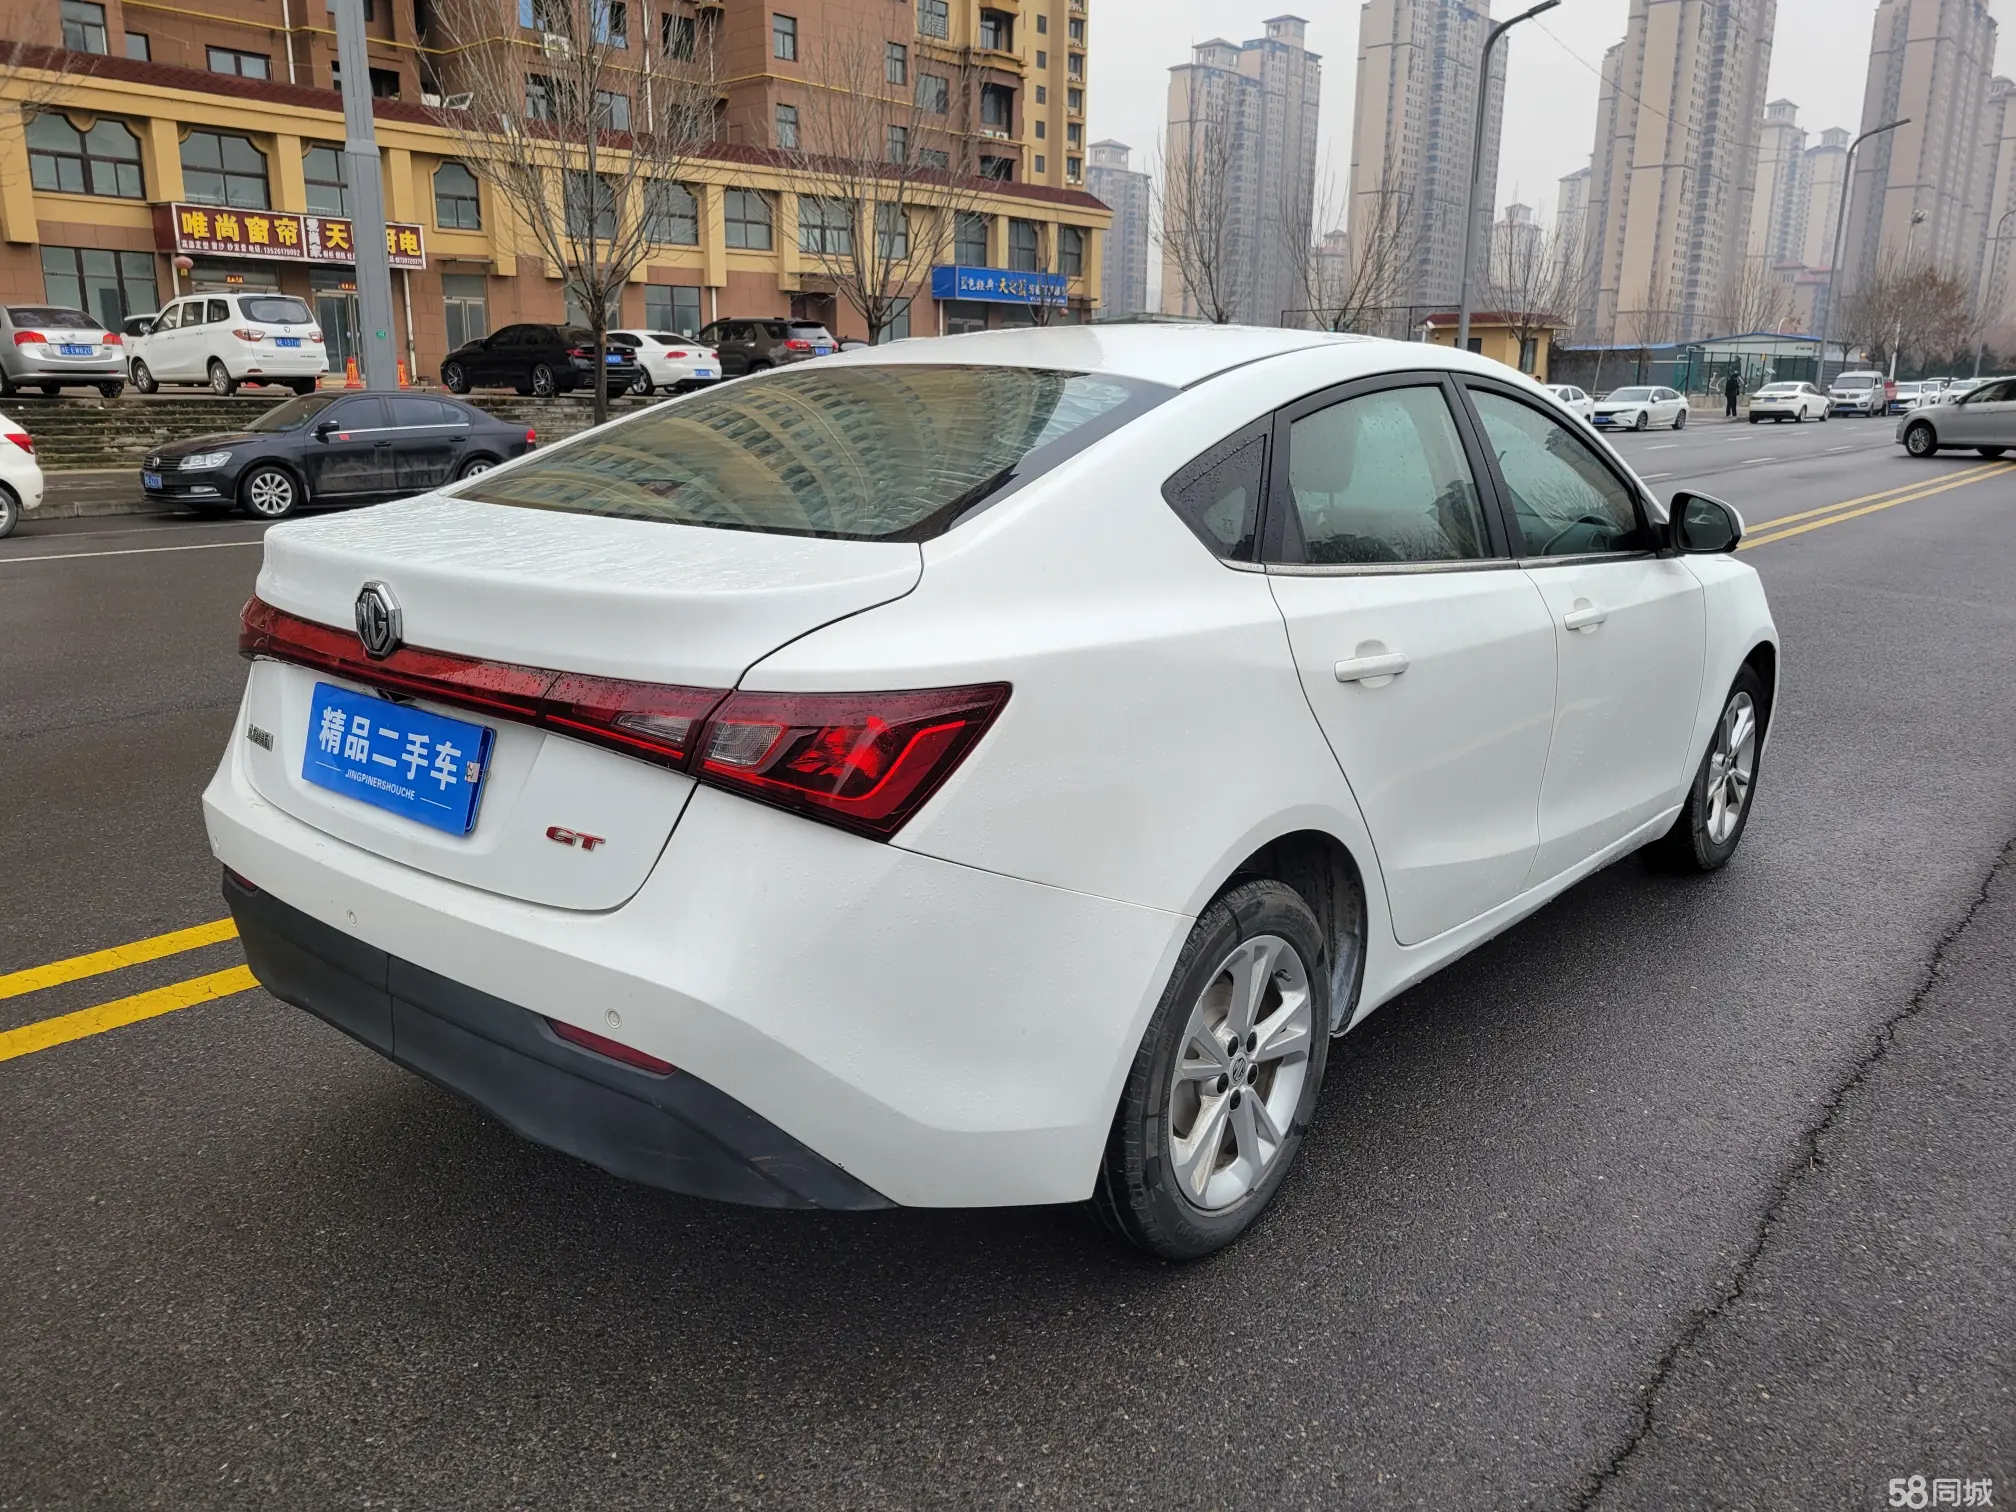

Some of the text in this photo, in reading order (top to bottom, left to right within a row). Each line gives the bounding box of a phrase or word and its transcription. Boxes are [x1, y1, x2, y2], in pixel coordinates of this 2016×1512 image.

[181, 210, 298, 246] 唯尚窗帘
[319, 706, 461, 791] 精品二手车
[345, 769, 416, 801] JINGPINERSHOUCHE
[546, 825, 606, 851] GT
